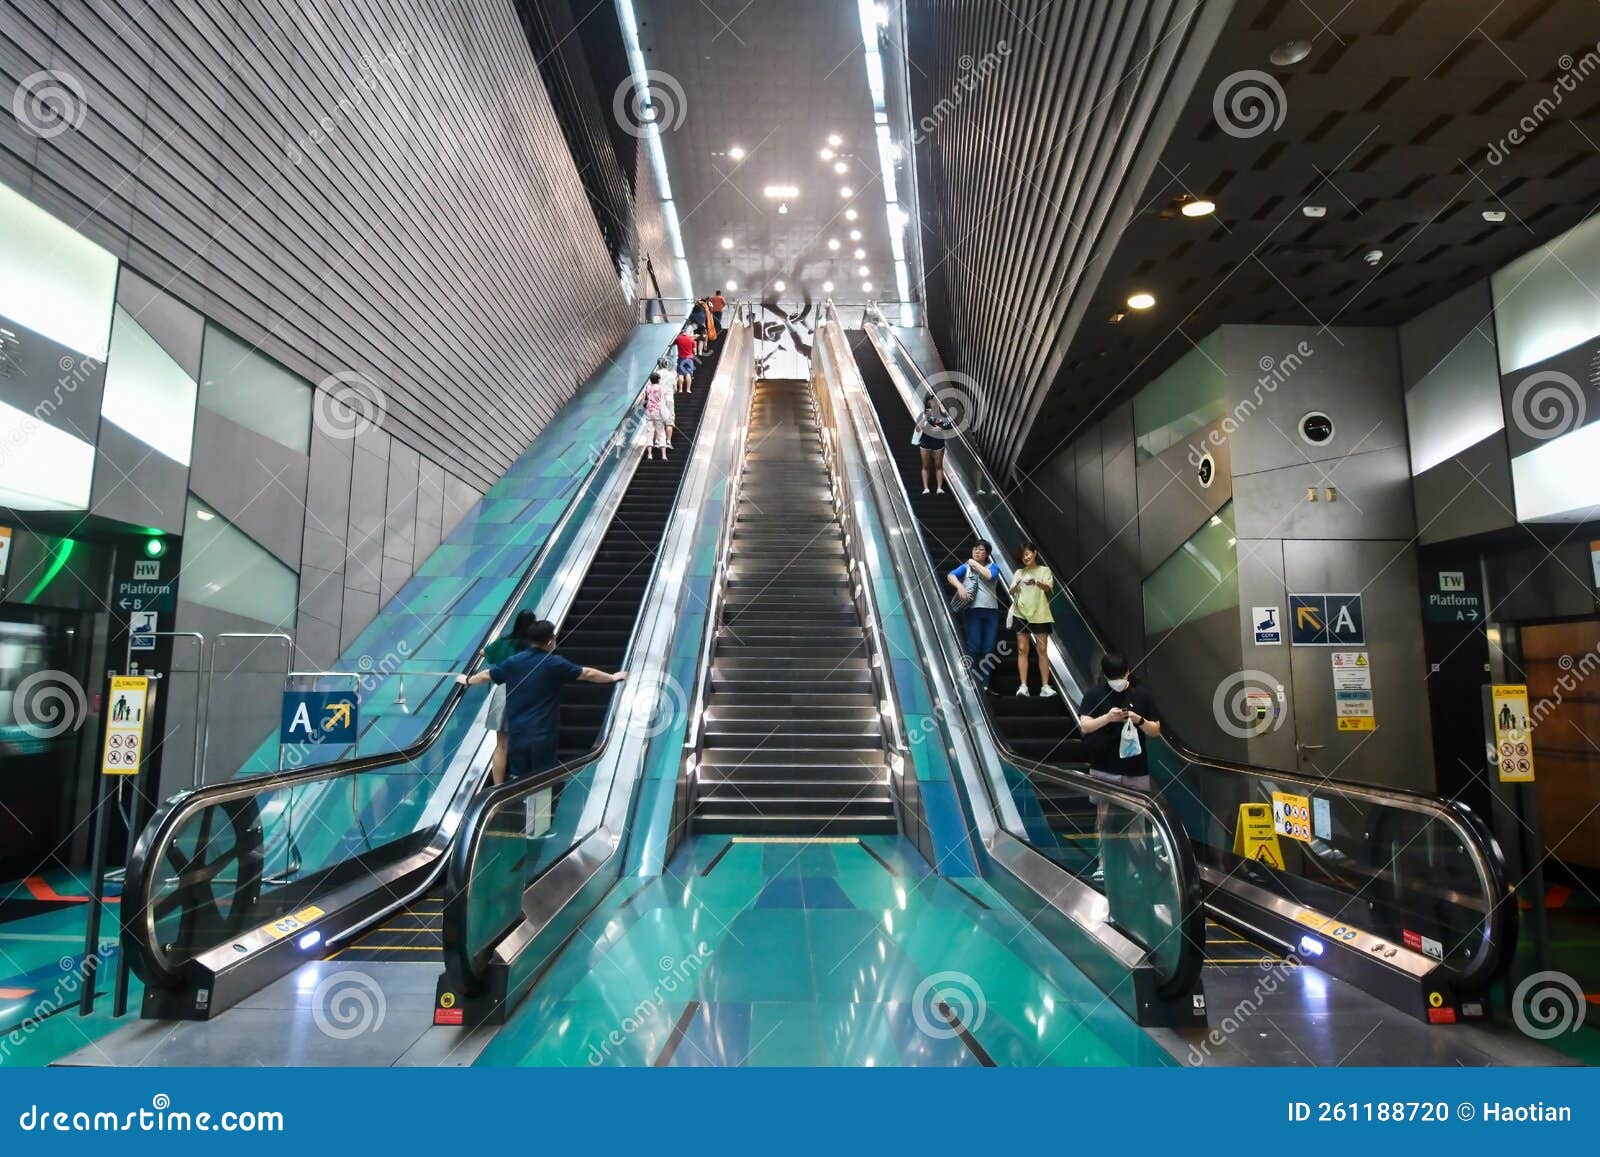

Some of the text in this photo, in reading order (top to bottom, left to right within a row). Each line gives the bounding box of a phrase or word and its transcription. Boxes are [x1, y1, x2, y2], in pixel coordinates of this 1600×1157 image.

[135, 562, 157, 576] HW
[1441, 575, 1462, 587] TW
[119, 582, 170, 595] Platform
[133, 599, 142, 610] B
[1429, 594, 1478, 606] Platform
[1335, 605, 1357, 633] A
[1456, 610, 1465, 621] A
[289, 702, 313, 733] A
